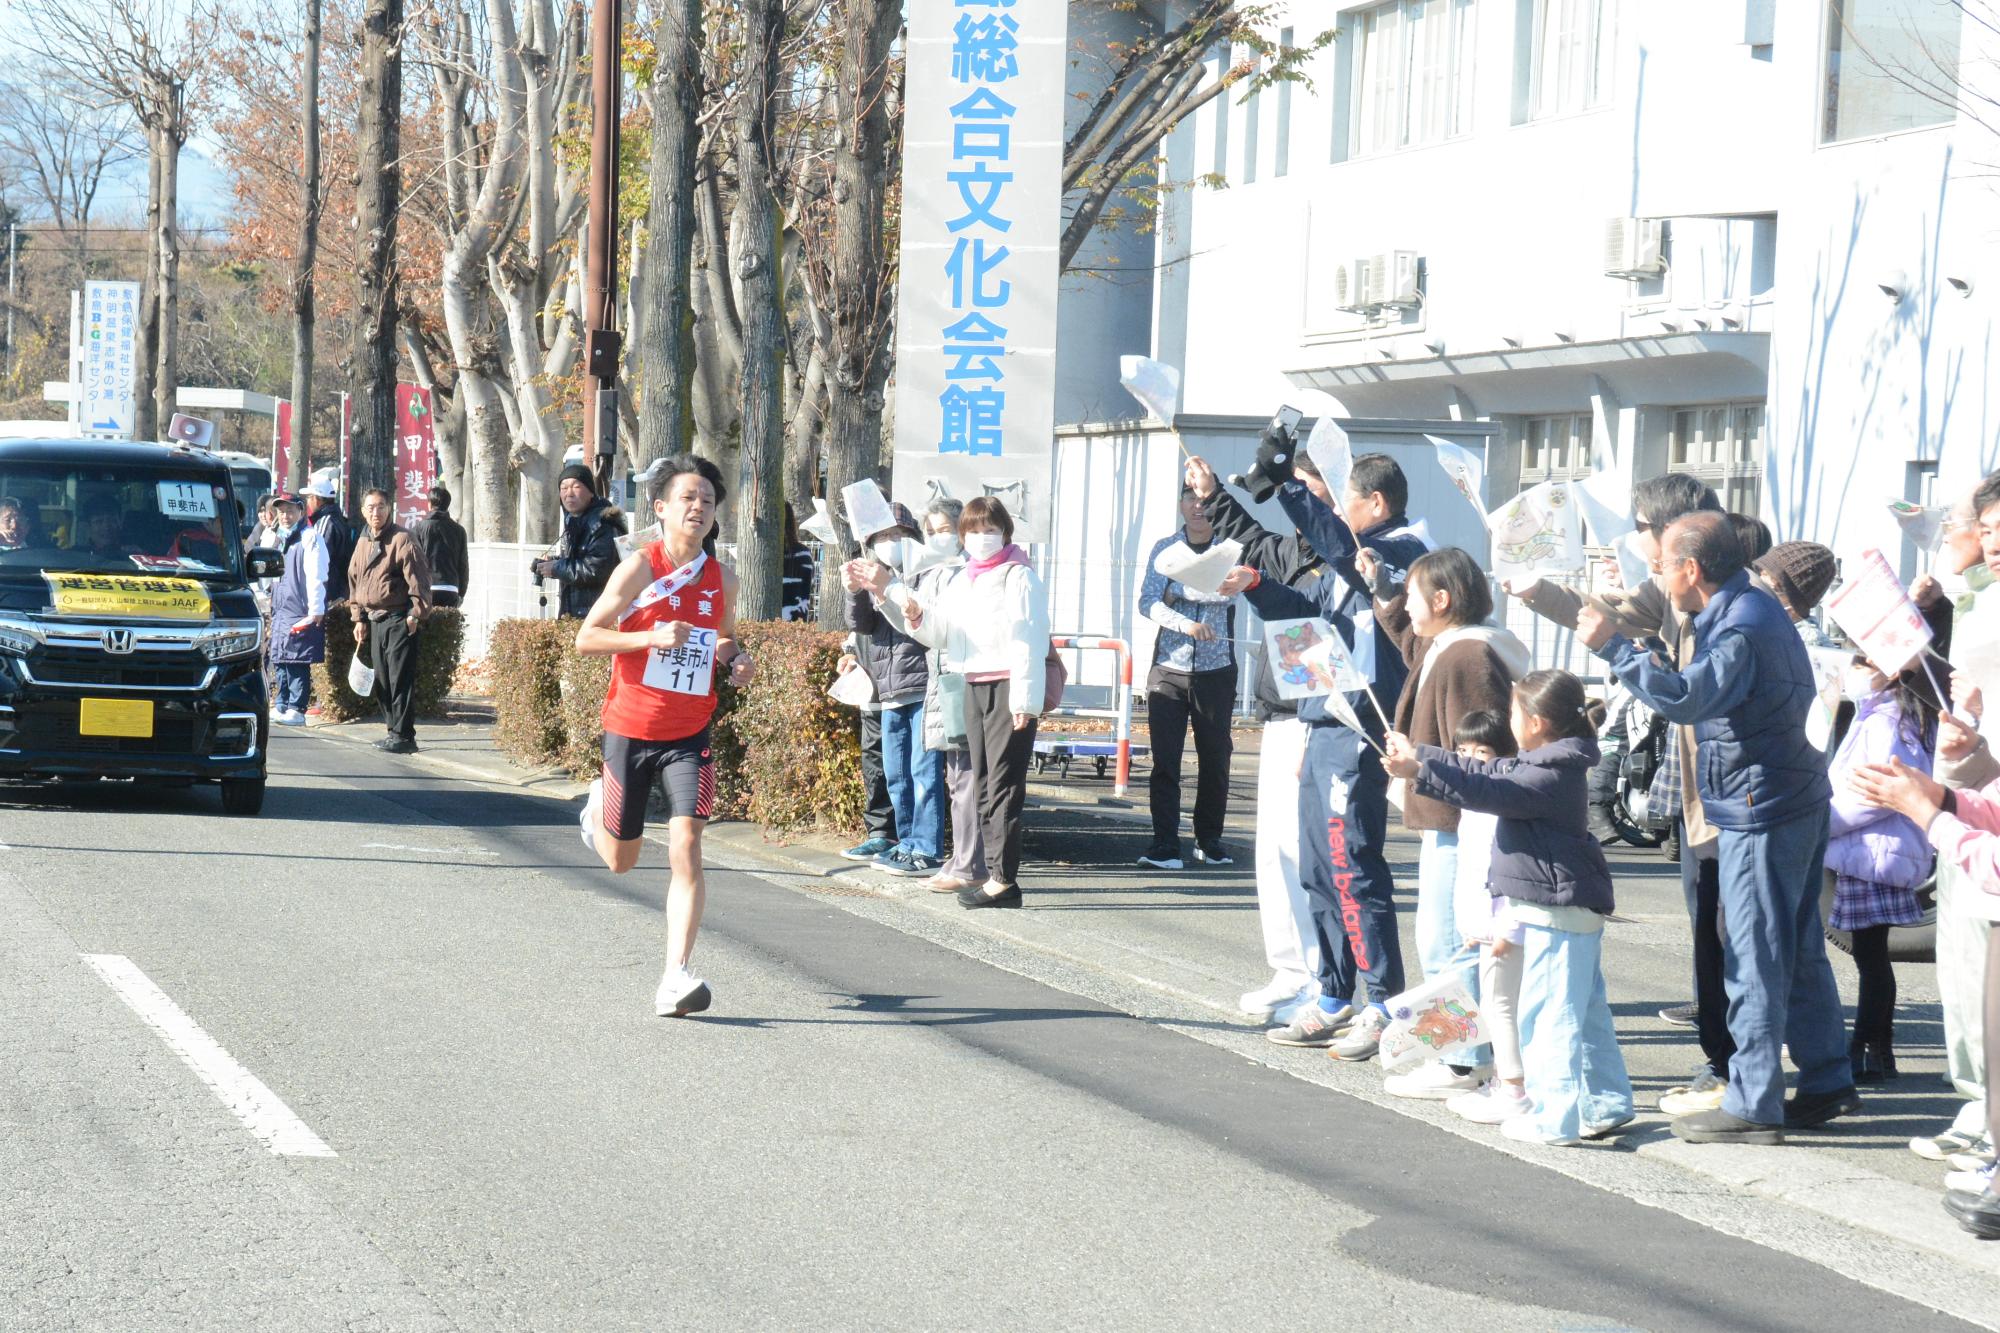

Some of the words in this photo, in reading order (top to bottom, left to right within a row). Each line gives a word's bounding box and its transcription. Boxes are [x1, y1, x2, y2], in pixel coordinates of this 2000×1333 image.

[938, 0, 1019, 457] 総合文化会館
[175, 484, 194, 498] 11
[399, 434, 427, 529] 甲斐市
[168, 499, 208, 513] 甲斐市A
[171, 597, 200, 608] JAAF
[688, 629, 713, 647] EC
[657, 646, 709, 670] 甲斐市A
[671, 669, 695, 691] 11
[1328, 817, 1348, 869] new
[1333, 872, 1370, 971] balance
